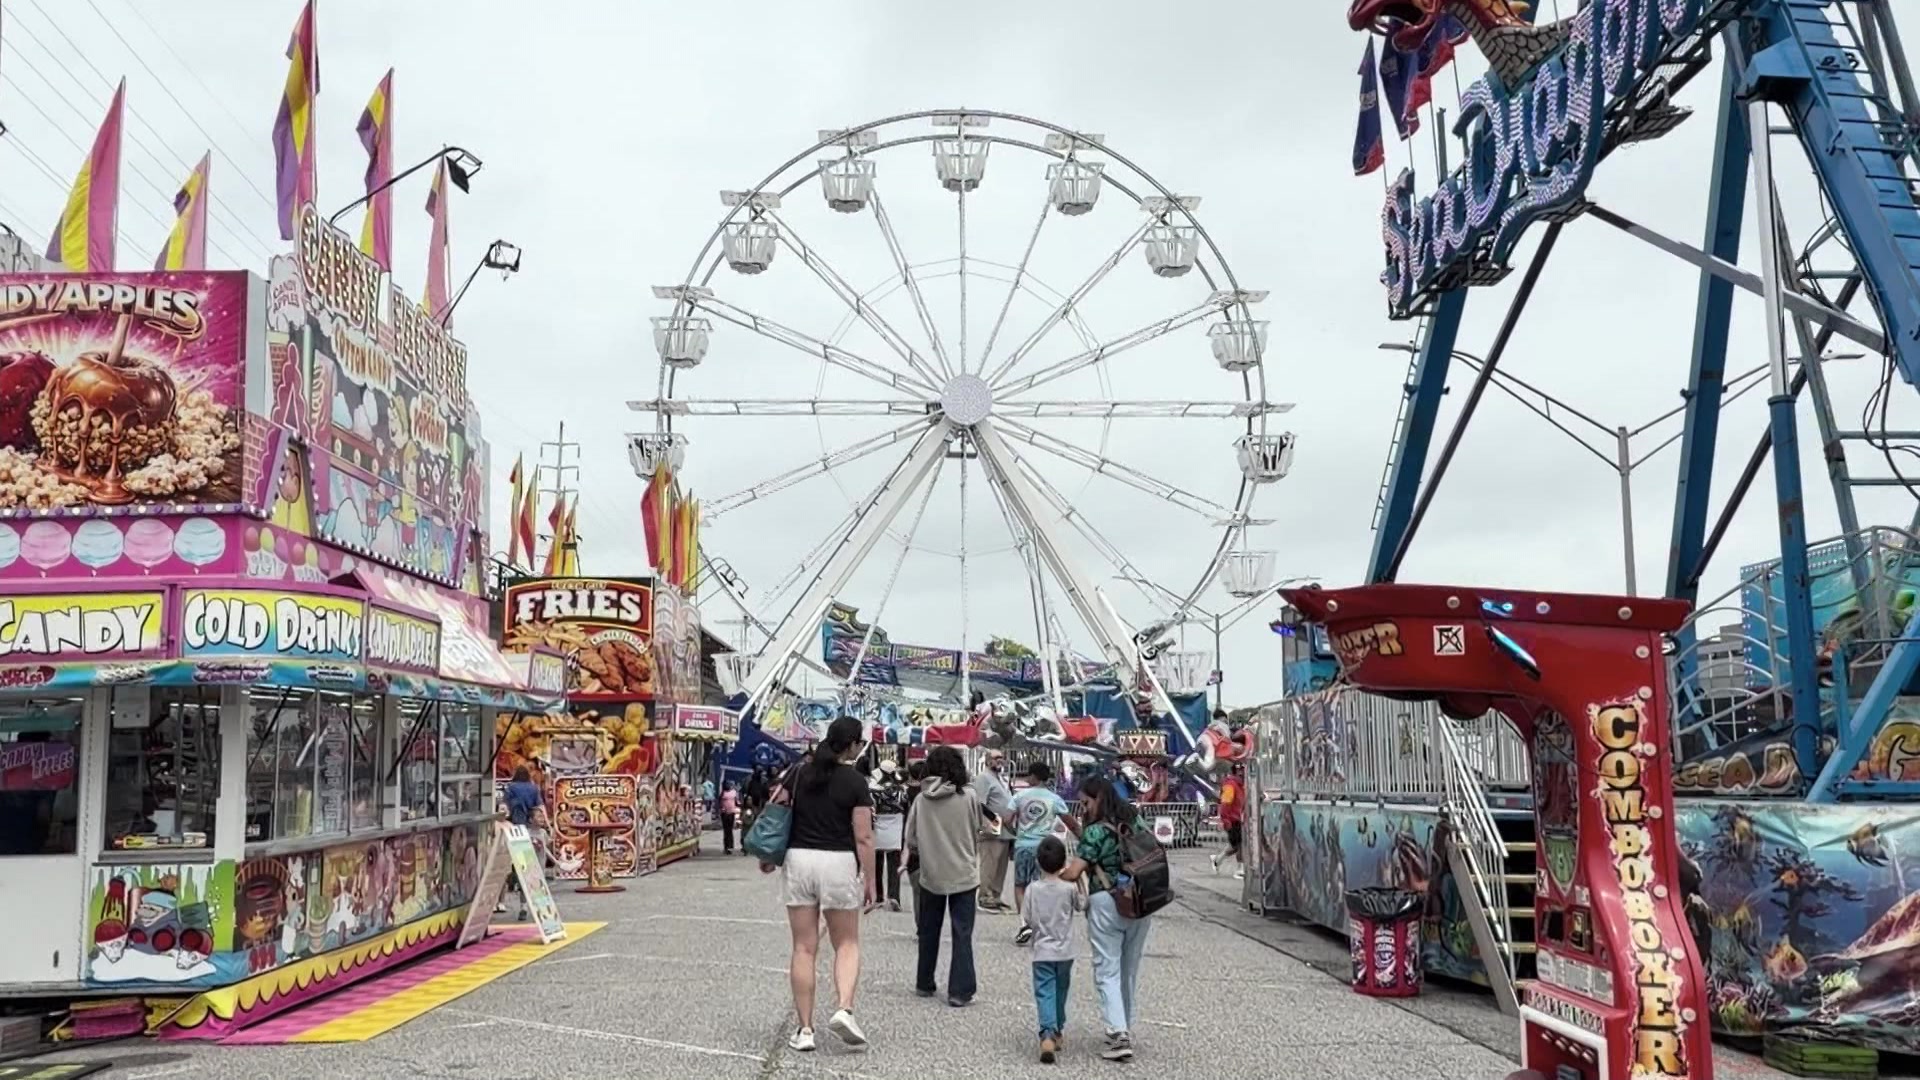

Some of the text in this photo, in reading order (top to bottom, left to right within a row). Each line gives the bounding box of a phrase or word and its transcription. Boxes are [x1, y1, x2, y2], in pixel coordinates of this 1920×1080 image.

[54, 281, 201, 330] APPLES
[0, 599, 153, 655] CANDY
[184, 592, 270, 649] COLD
[515, 588, 642, 624] FRIES
[565, 786, 628, 798] COMBOS!
